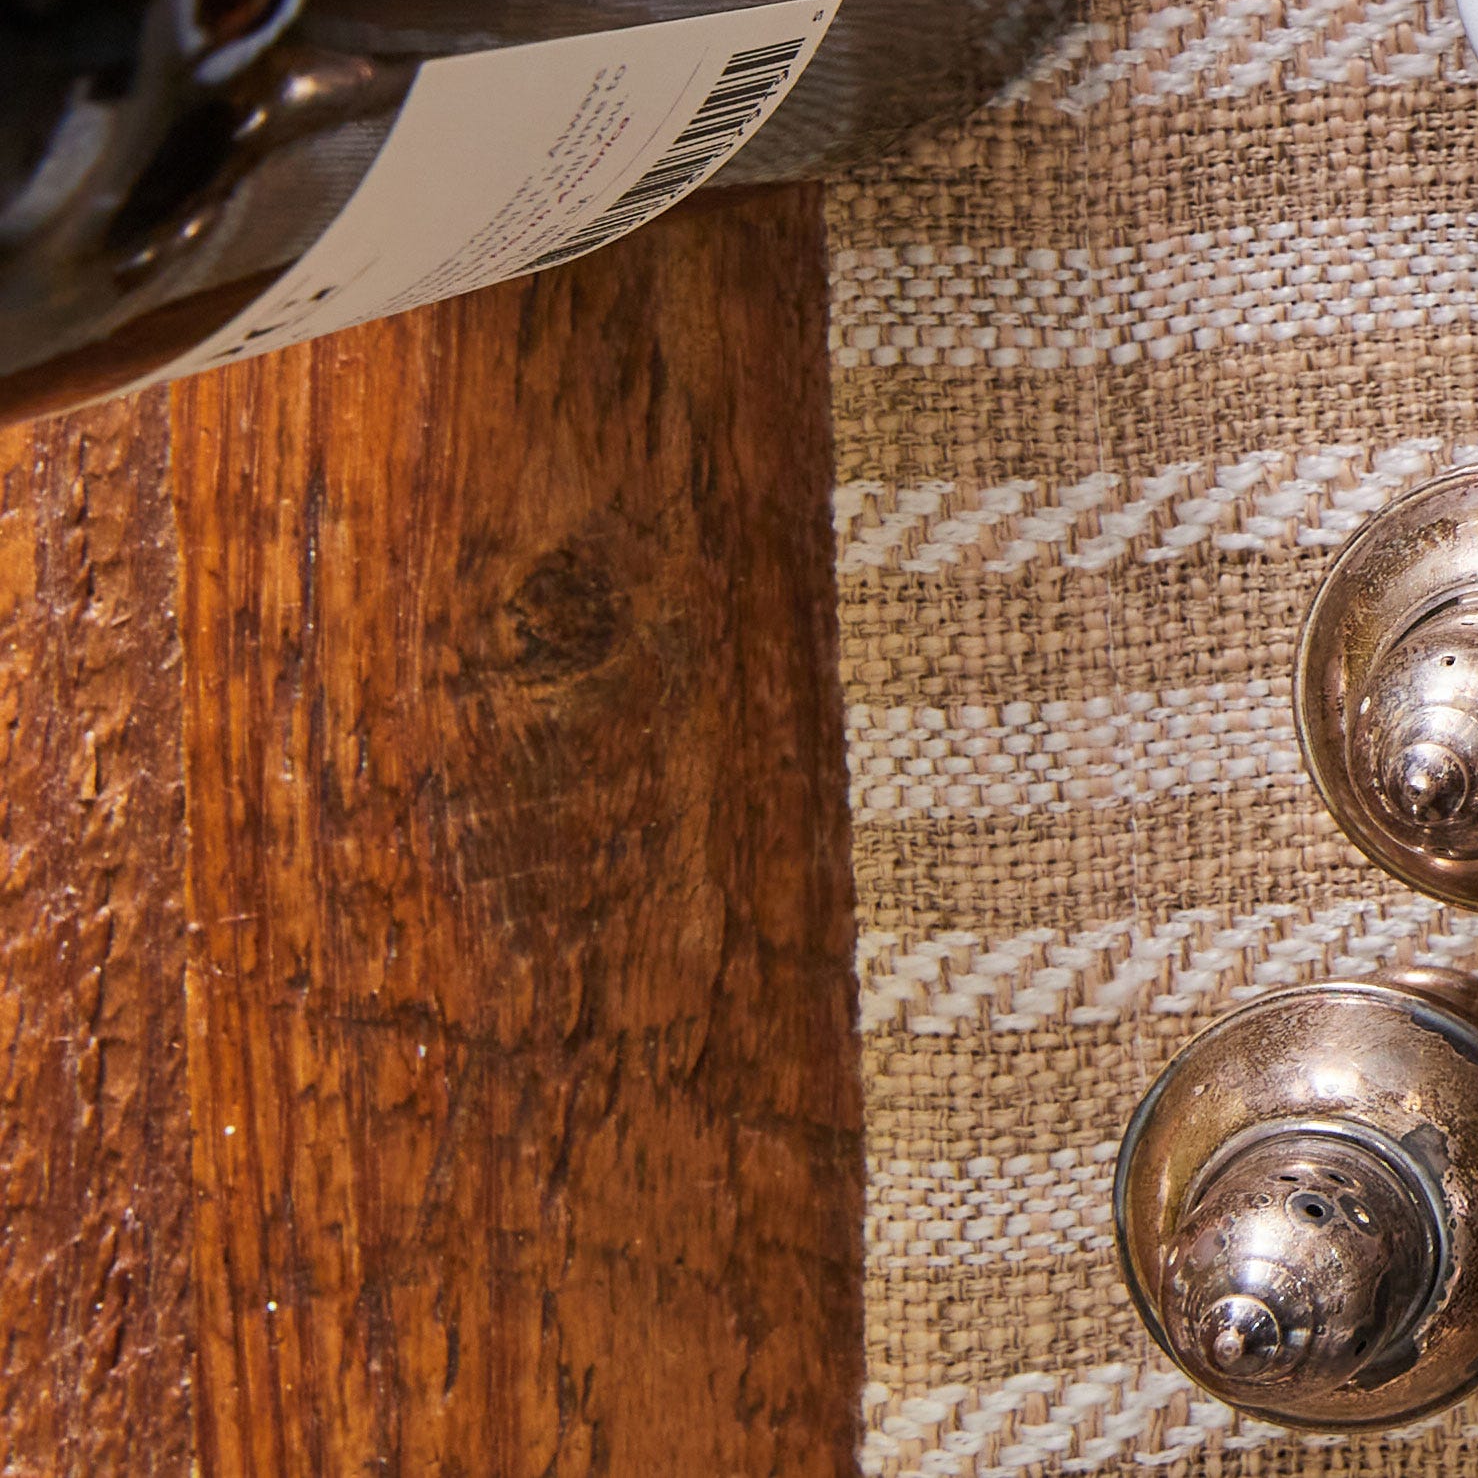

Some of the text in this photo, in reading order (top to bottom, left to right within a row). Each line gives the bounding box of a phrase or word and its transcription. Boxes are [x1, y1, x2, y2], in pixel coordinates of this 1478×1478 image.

[547, 67, 608, 158] Always
[563, 99, 608, 156] time
[605, 64, 627, 92] to
